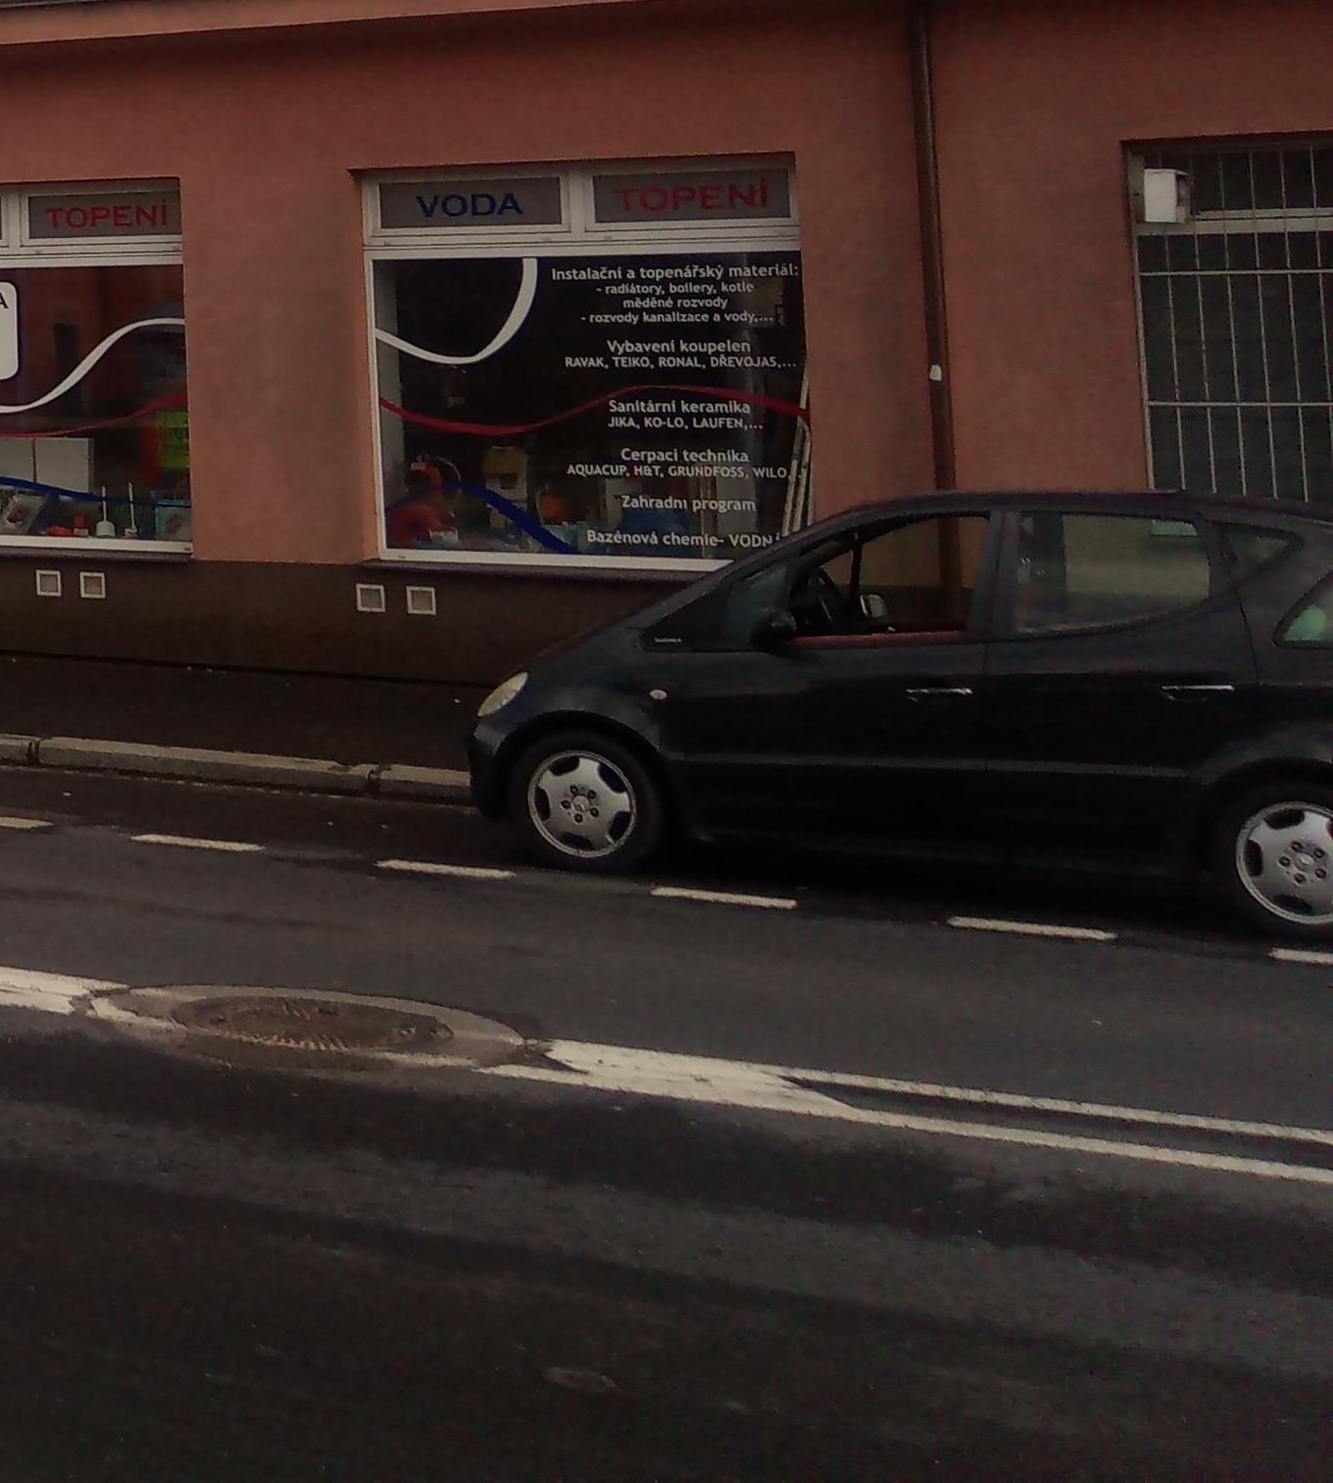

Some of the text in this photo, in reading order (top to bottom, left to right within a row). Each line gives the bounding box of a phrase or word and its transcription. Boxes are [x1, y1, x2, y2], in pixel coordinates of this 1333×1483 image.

[614, 177, 769, 212] TOPENÍ
[416, 193, 523, 218] VODA
[45, 199, 168, 230] TOPENÍ
[626, 269, 636, 280] a
[677, 296, 728, 309] rozvody
[589, 311, 640, 325] rozvody
[642, 311, 709, 323] kanalizace
[712, 313, 721, 323] a
[679, 339, 752, 355] koupelen
[658, 356, 707, 369] RONAL,
[680, 399, 751, 415] keramika
[607, 417, 641, 430] JIKA,
[683, 448, 750, 463] technika
[692, 499, 757, 514] program
